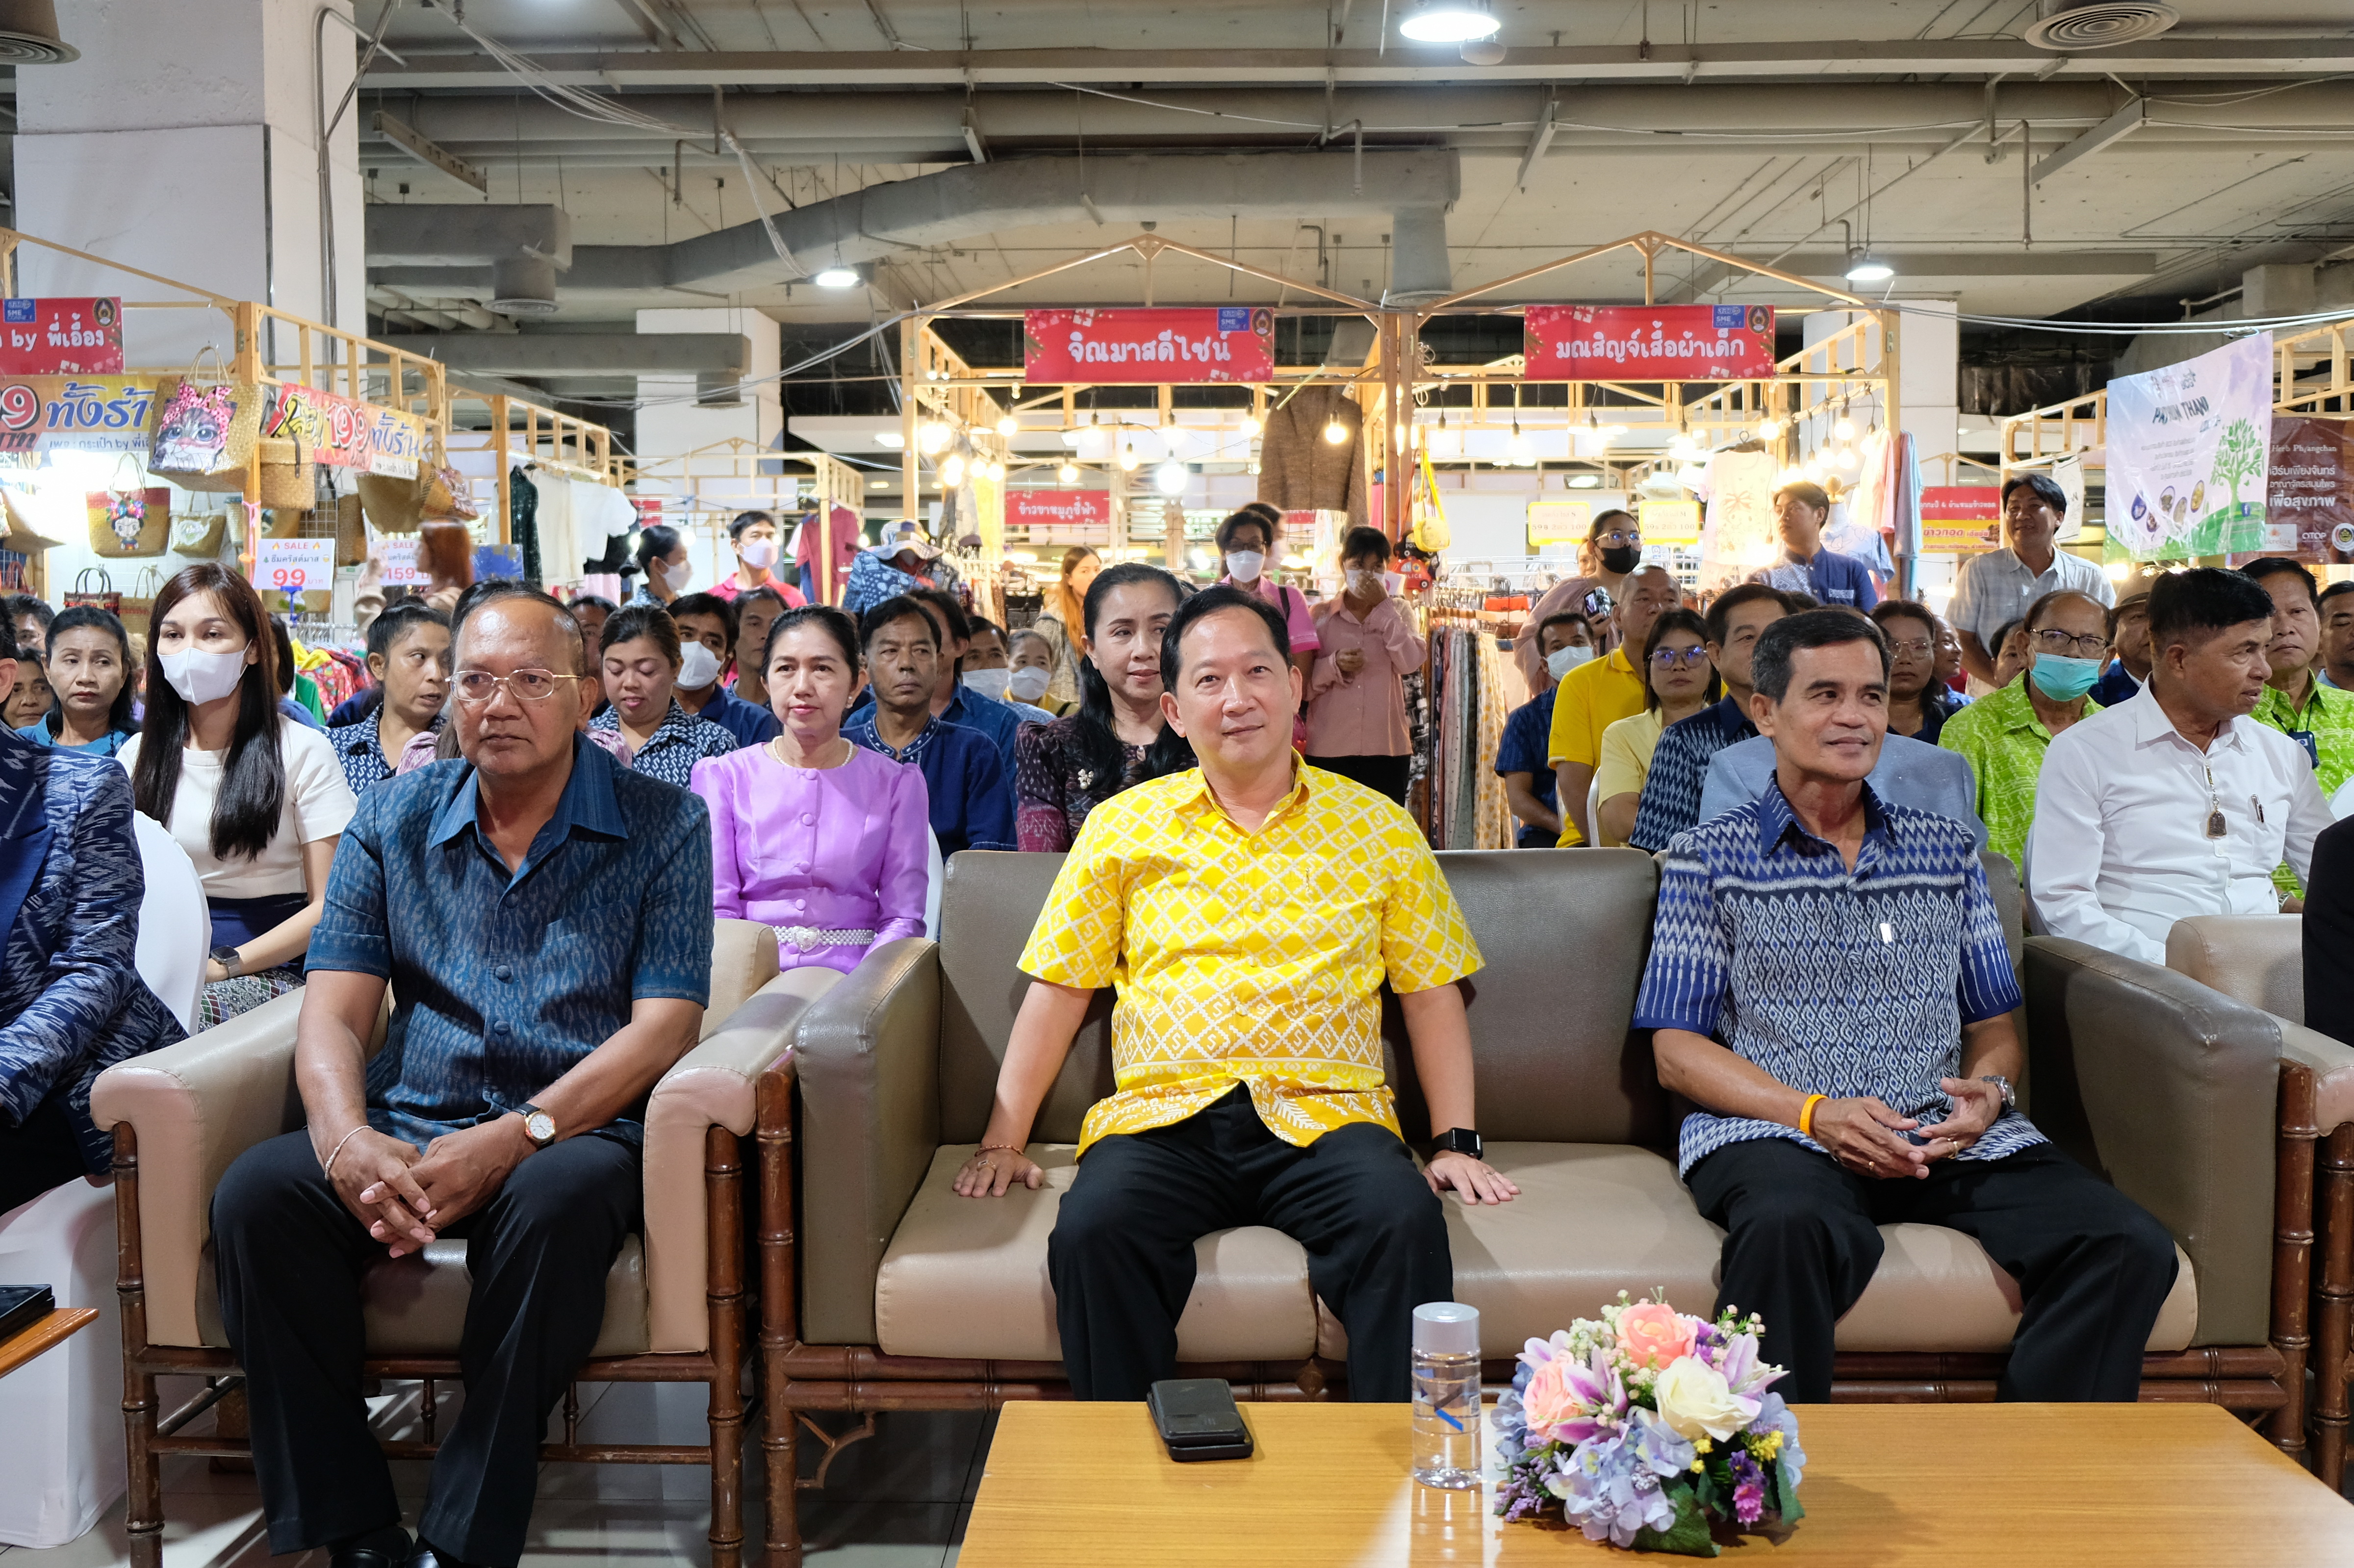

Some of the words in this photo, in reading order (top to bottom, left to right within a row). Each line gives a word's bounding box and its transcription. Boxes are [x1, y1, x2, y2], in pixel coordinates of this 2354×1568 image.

[11, 329, 37, 352] by
[47, 312, 104, 348] พี่เอื้อง
[1068, 329, 1231, 363] จิณมาสดีไซน์
[46, 381, 154, 428] ทั้งร้า
[327, 402, 367, 451] 199
[116, 438, 128, 450] by
[2270, 489, 2336, 511] เพื่อสุขภาพ
[272, 568, 306, 587] 99
[386, 567, 415, 580] 159
